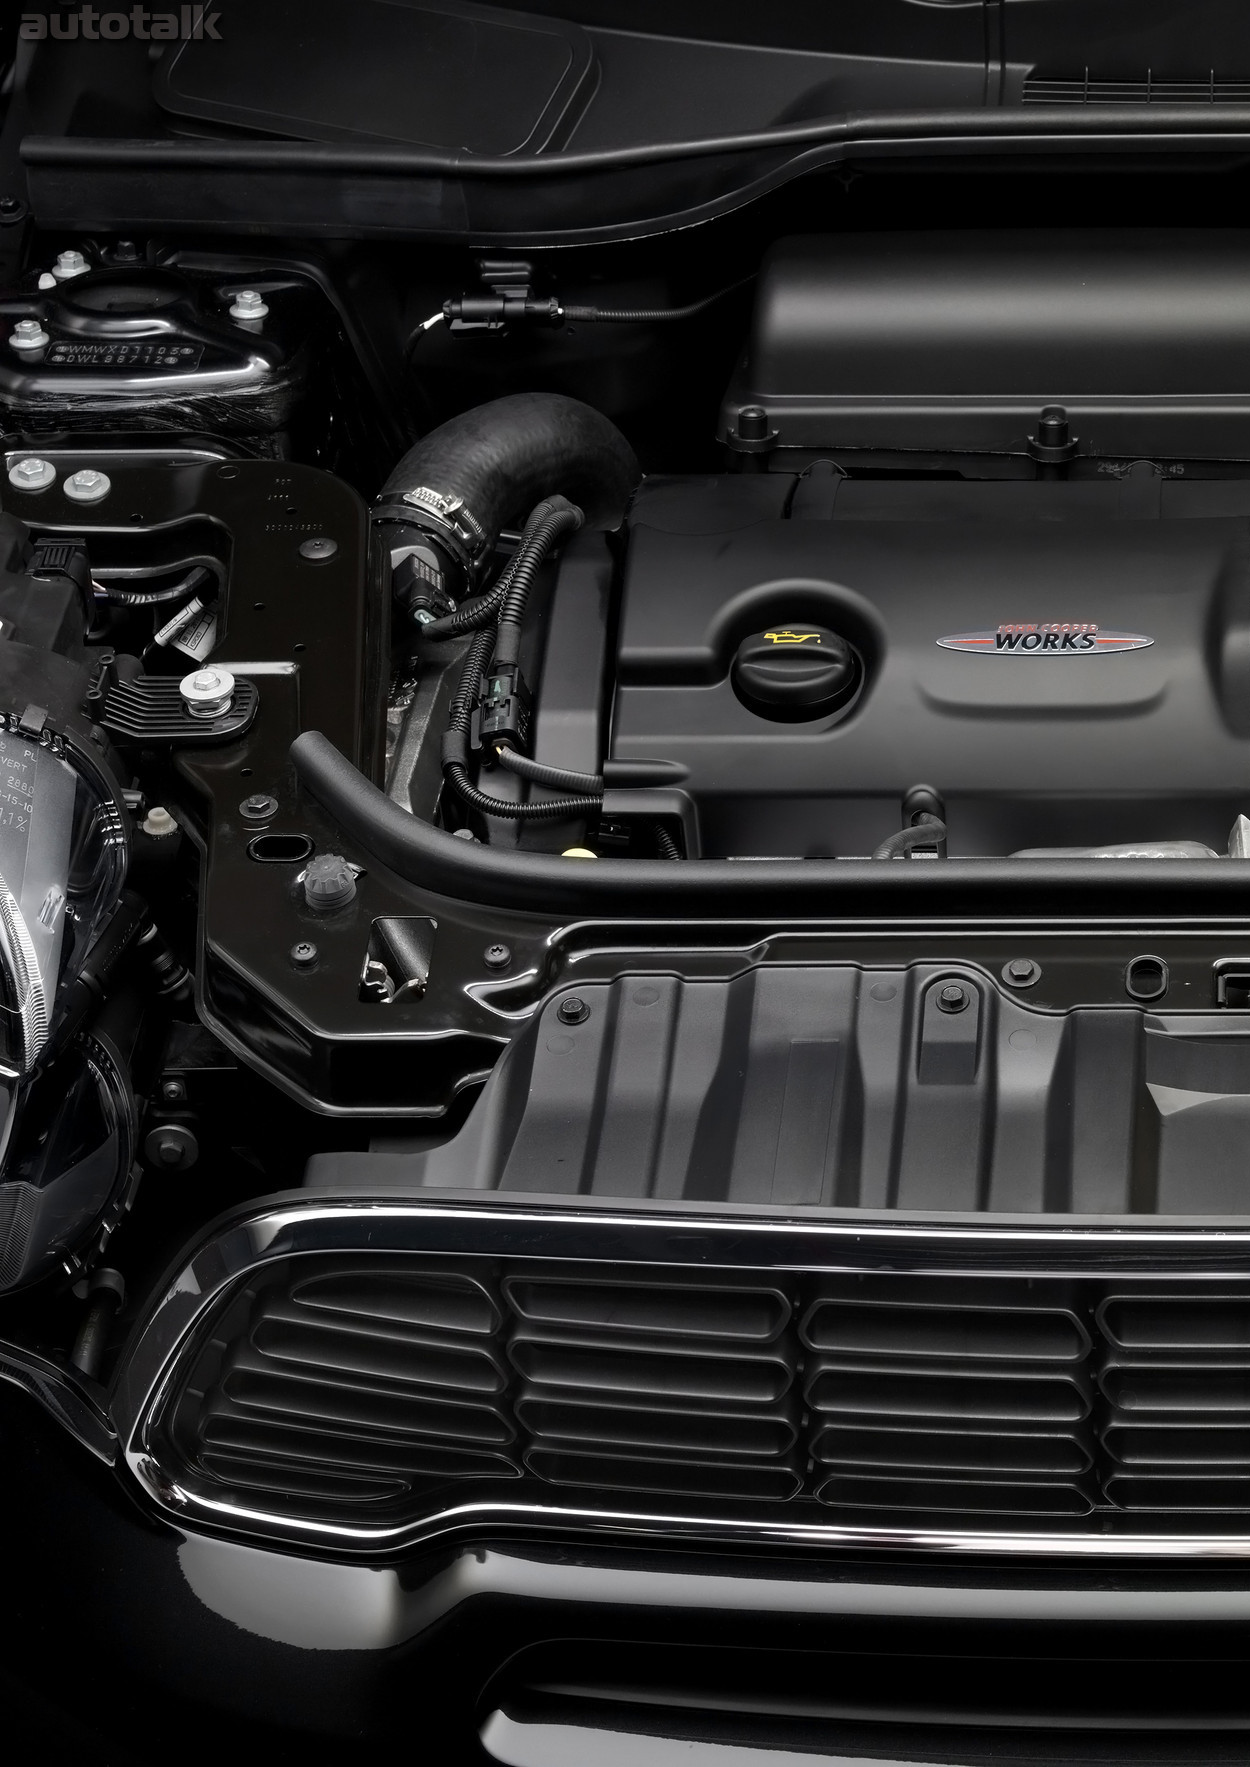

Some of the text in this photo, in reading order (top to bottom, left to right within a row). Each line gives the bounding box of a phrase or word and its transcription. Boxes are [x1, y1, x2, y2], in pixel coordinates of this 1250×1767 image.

[997, 623, 1099, 633] JOHN COOPER
[995, 633, 1097, 650] WORKS
